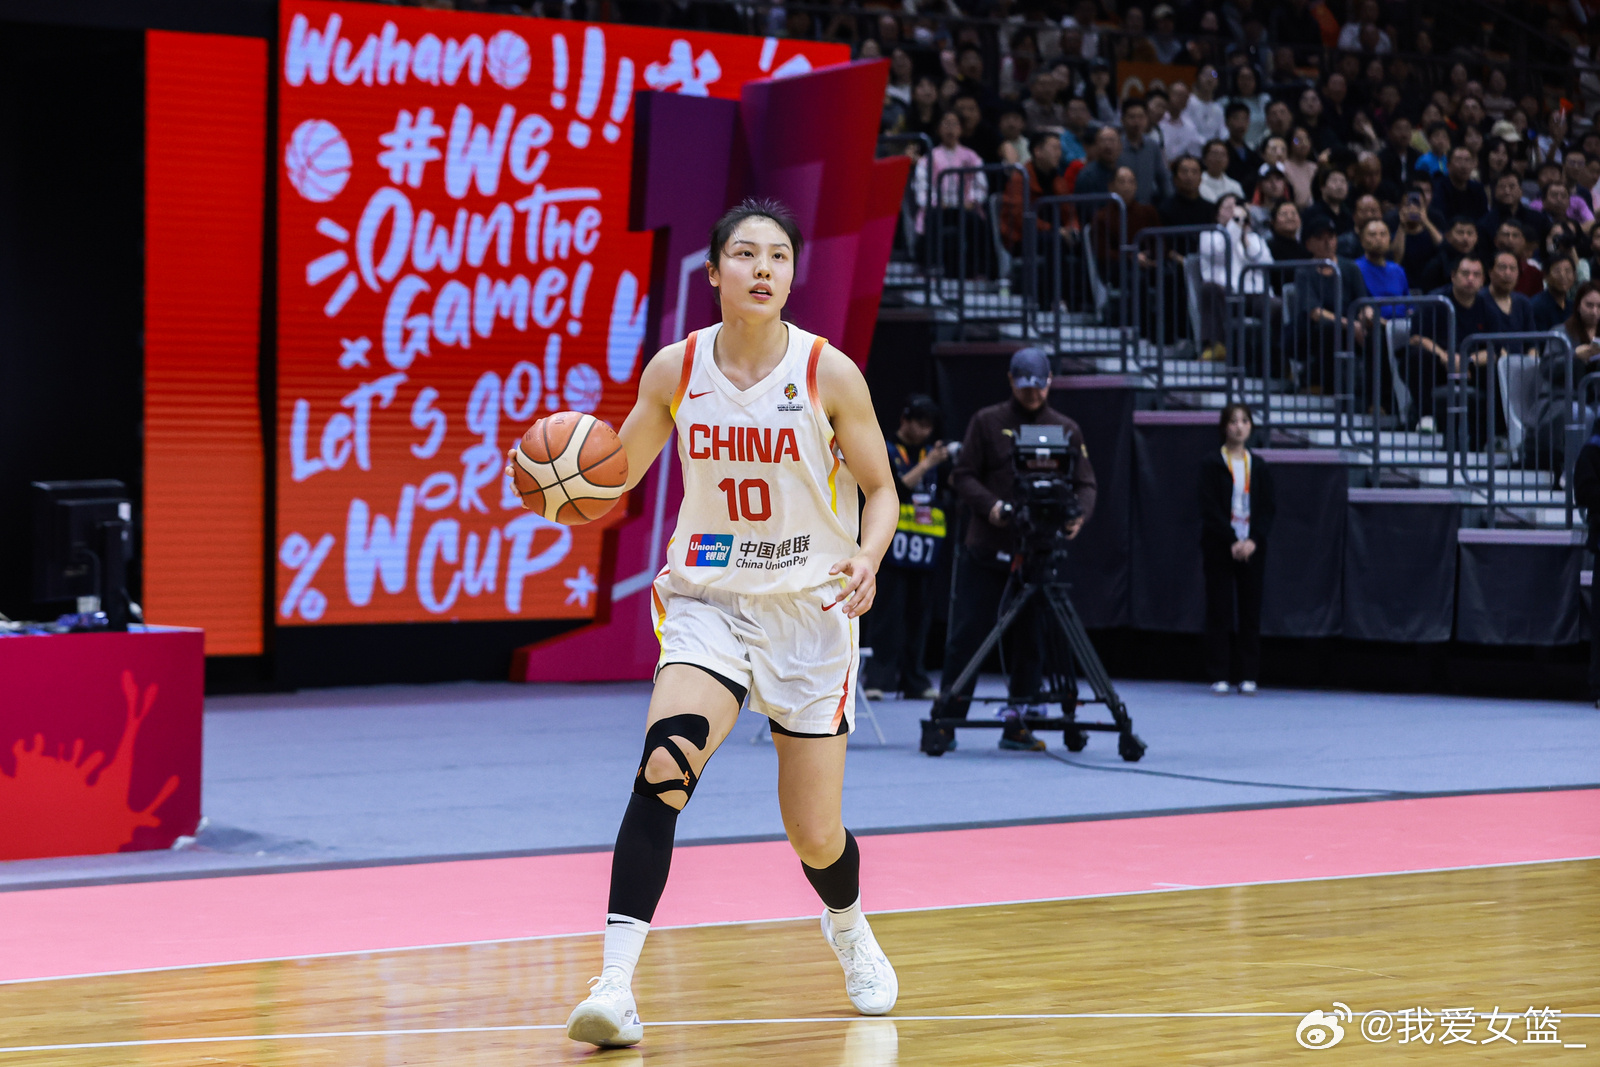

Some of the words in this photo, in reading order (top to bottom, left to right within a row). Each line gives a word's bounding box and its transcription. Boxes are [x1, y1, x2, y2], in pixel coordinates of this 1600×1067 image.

[284, 13, 486, 88] Wuhan
[355, 186, 515, 293] Own
[689, 423, 801, 464] CHINA
[717, 477, 772, 522] 10
[690, 541, 731, 557] UnionPay
[735, 558, 763, 570] China
[739, 534, 811, 560] 中国银联
[892, 532, 935, 565] 097
